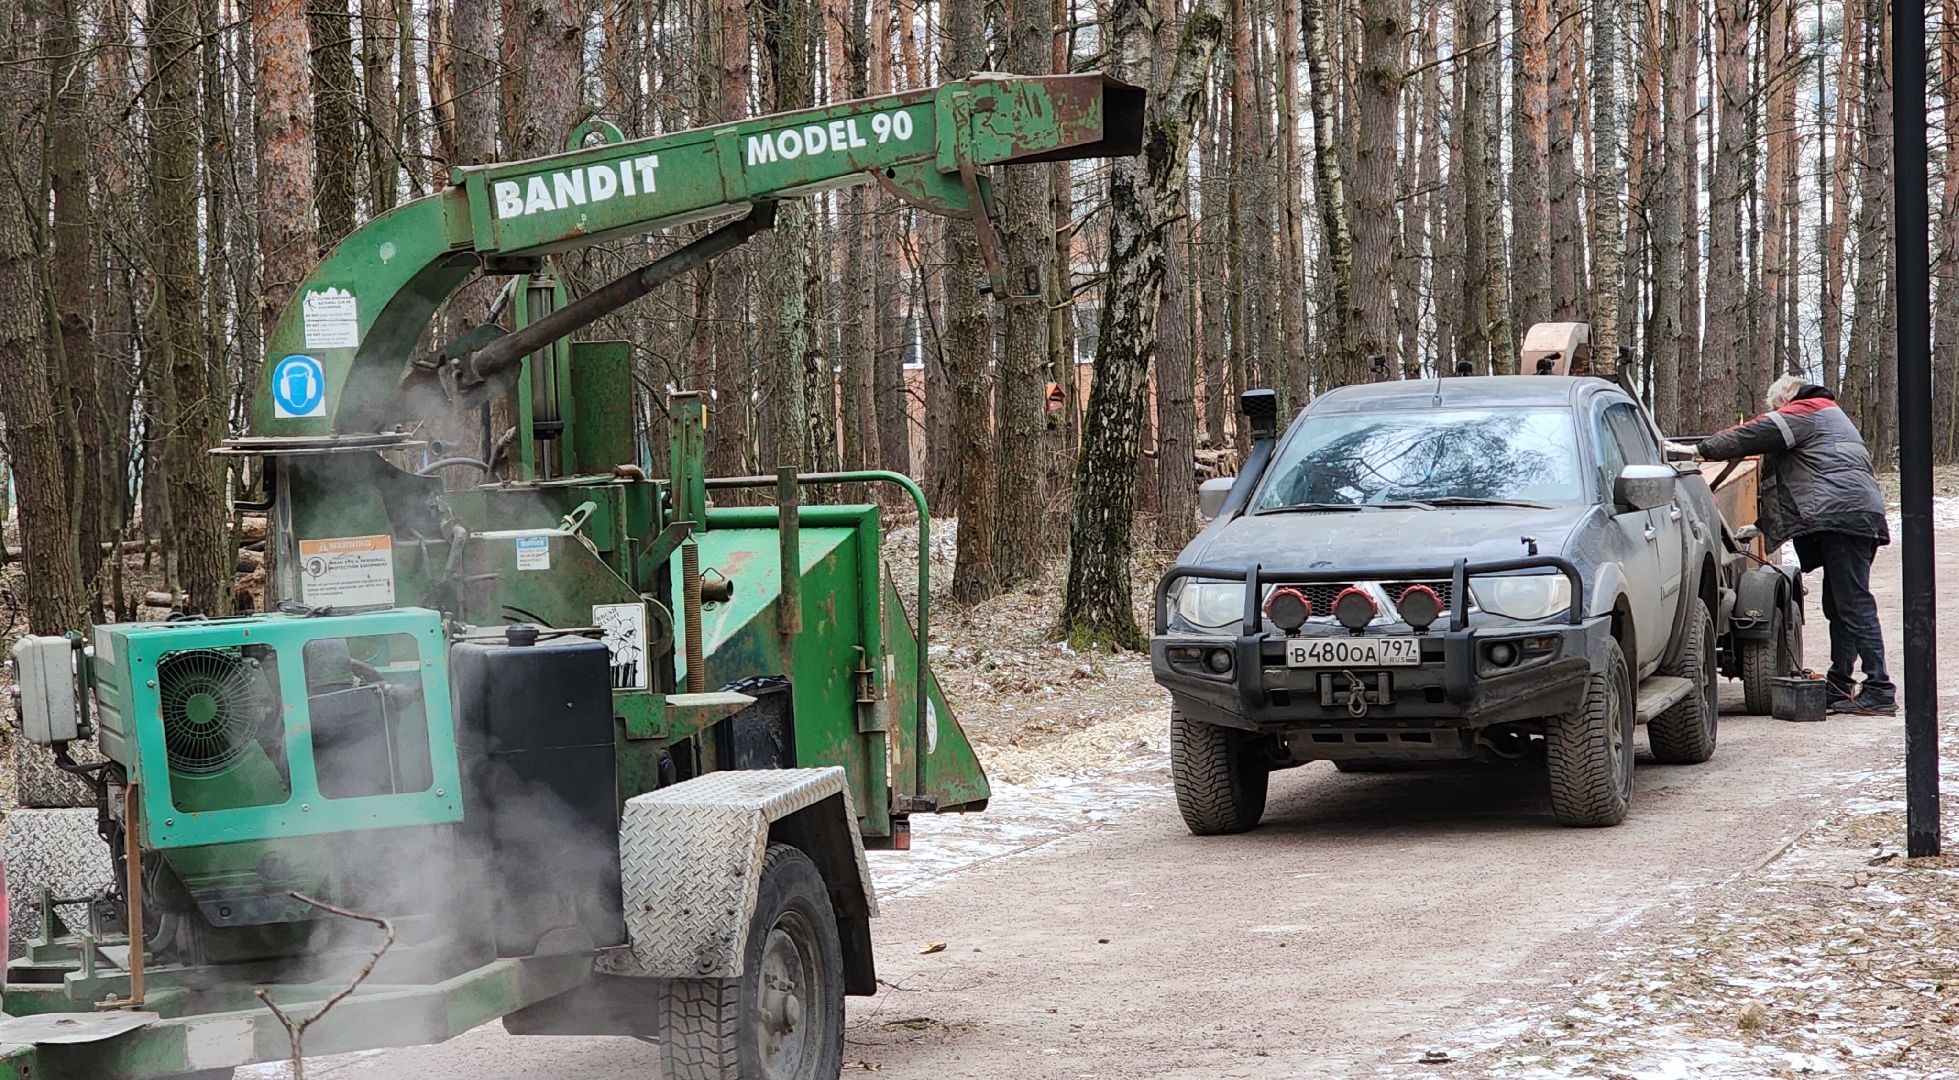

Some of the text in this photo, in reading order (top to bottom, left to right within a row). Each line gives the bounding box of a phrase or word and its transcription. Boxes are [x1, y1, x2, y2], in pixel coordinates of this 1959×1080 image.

[747, 110, 913, 166] MODEL 90
[494, 155, 660, 219] BANDIT
[328, 540, 372, 549] WARNING
[1381, 640, 1413, 656] 797
